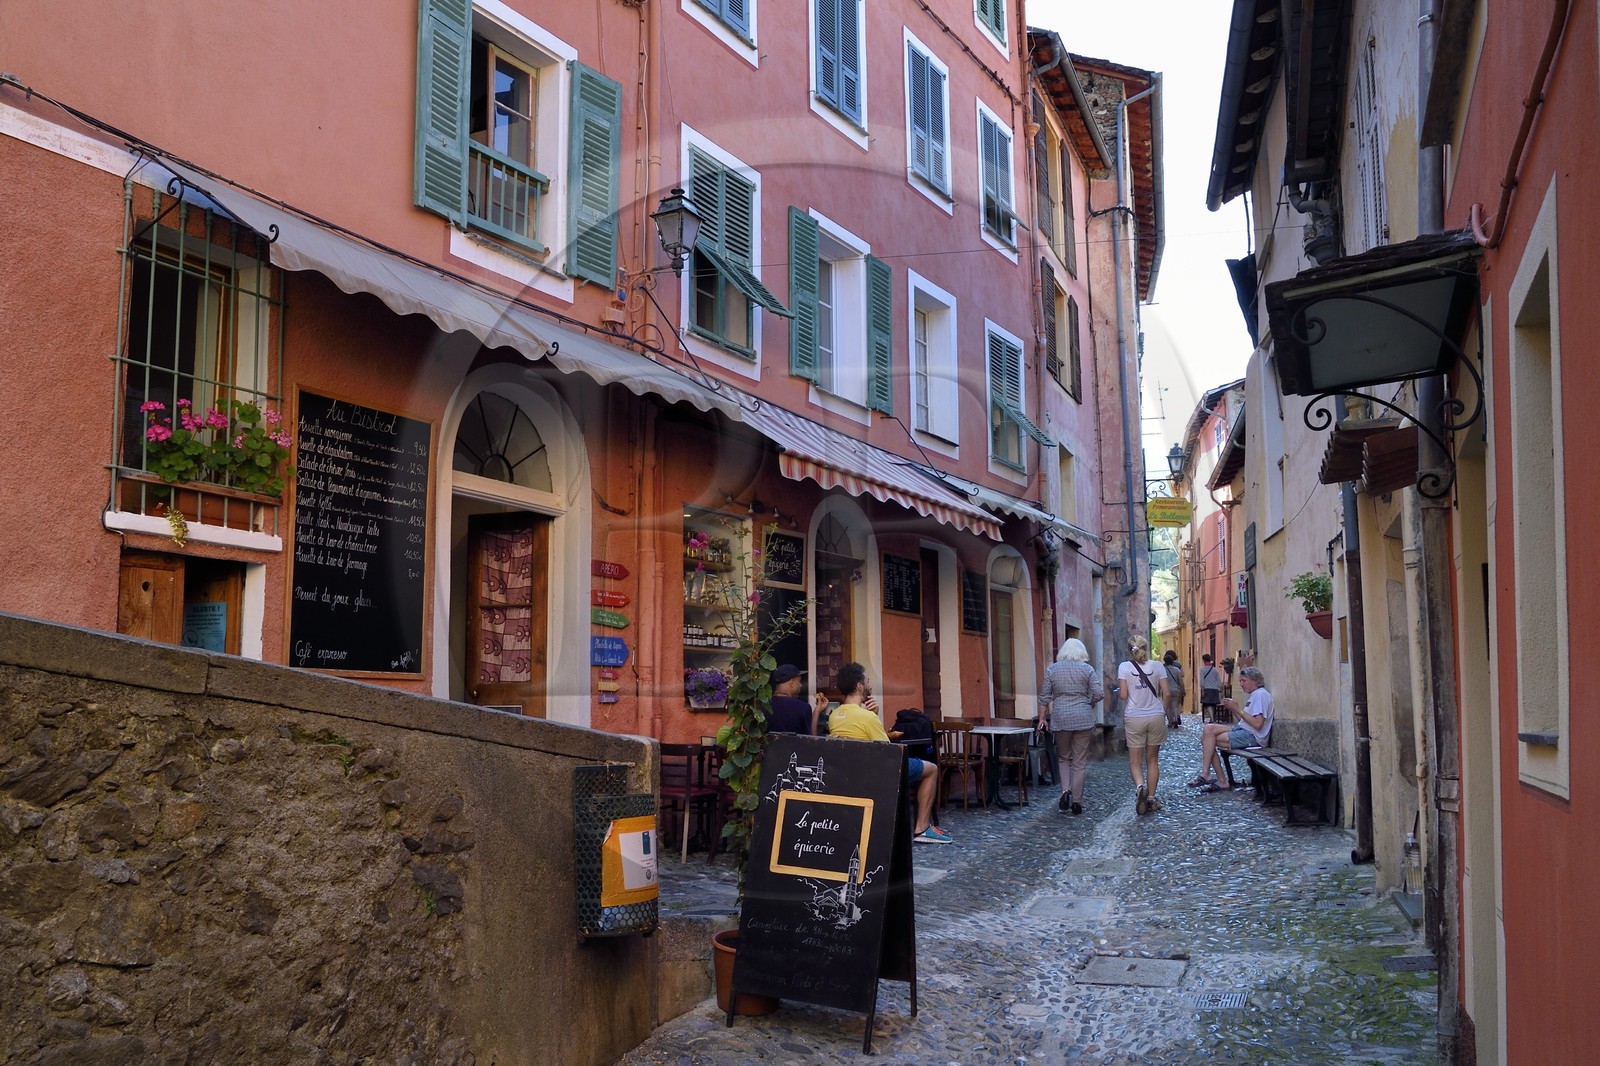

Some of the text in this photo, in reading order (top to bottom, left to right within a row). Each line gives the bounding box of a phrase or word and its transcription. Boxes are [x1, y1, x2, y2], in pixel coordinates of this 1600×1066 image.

[326, 400, 398, 435] Au Bistrot
[298, 452, 318, 471] Salade
[318, 457, 326, 473] de
[296, 470, 317, 490] Salade
[317, 477, 325, 491] de
[1159, 512, 1191, 521] Bellevue
[317, 531, 324, 545] de
[337, 534, 344, 549] de
[317, 550, 324, 565] de
[337, 552, 344, 568] de
[295, 586, 318, 602] Dessert
[321, 587, 331, 603] du
[295, 640, 348, 666] Café expresso
[794, 811, 840, 836] La petite
[793, 838, 835, 858] épicerie
